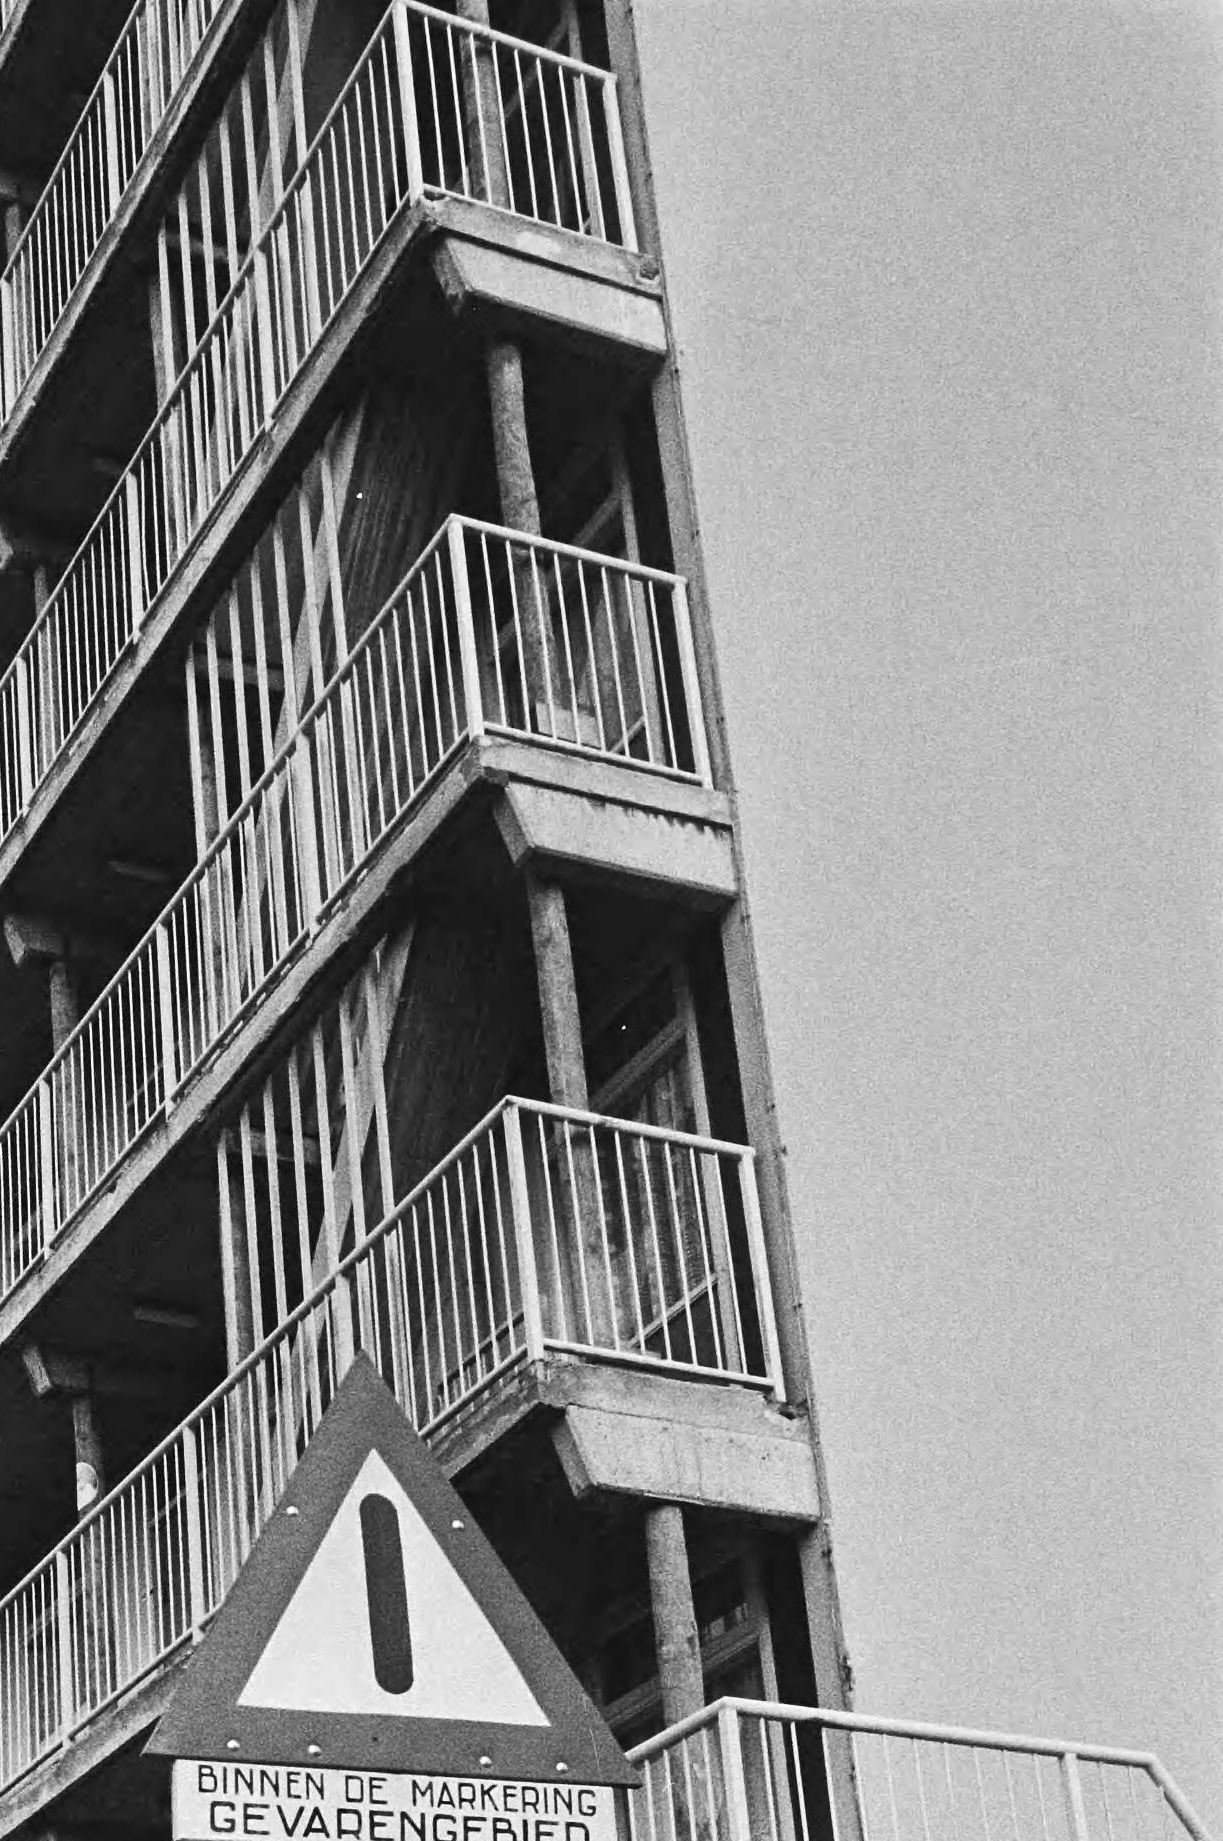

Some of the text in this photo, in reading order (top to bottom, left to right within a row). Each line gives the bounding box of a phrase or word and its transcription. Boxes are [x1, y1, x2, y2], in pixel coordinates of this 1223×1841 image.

[198, 1764, 597, 1817] BINNEN DE MARKERING
